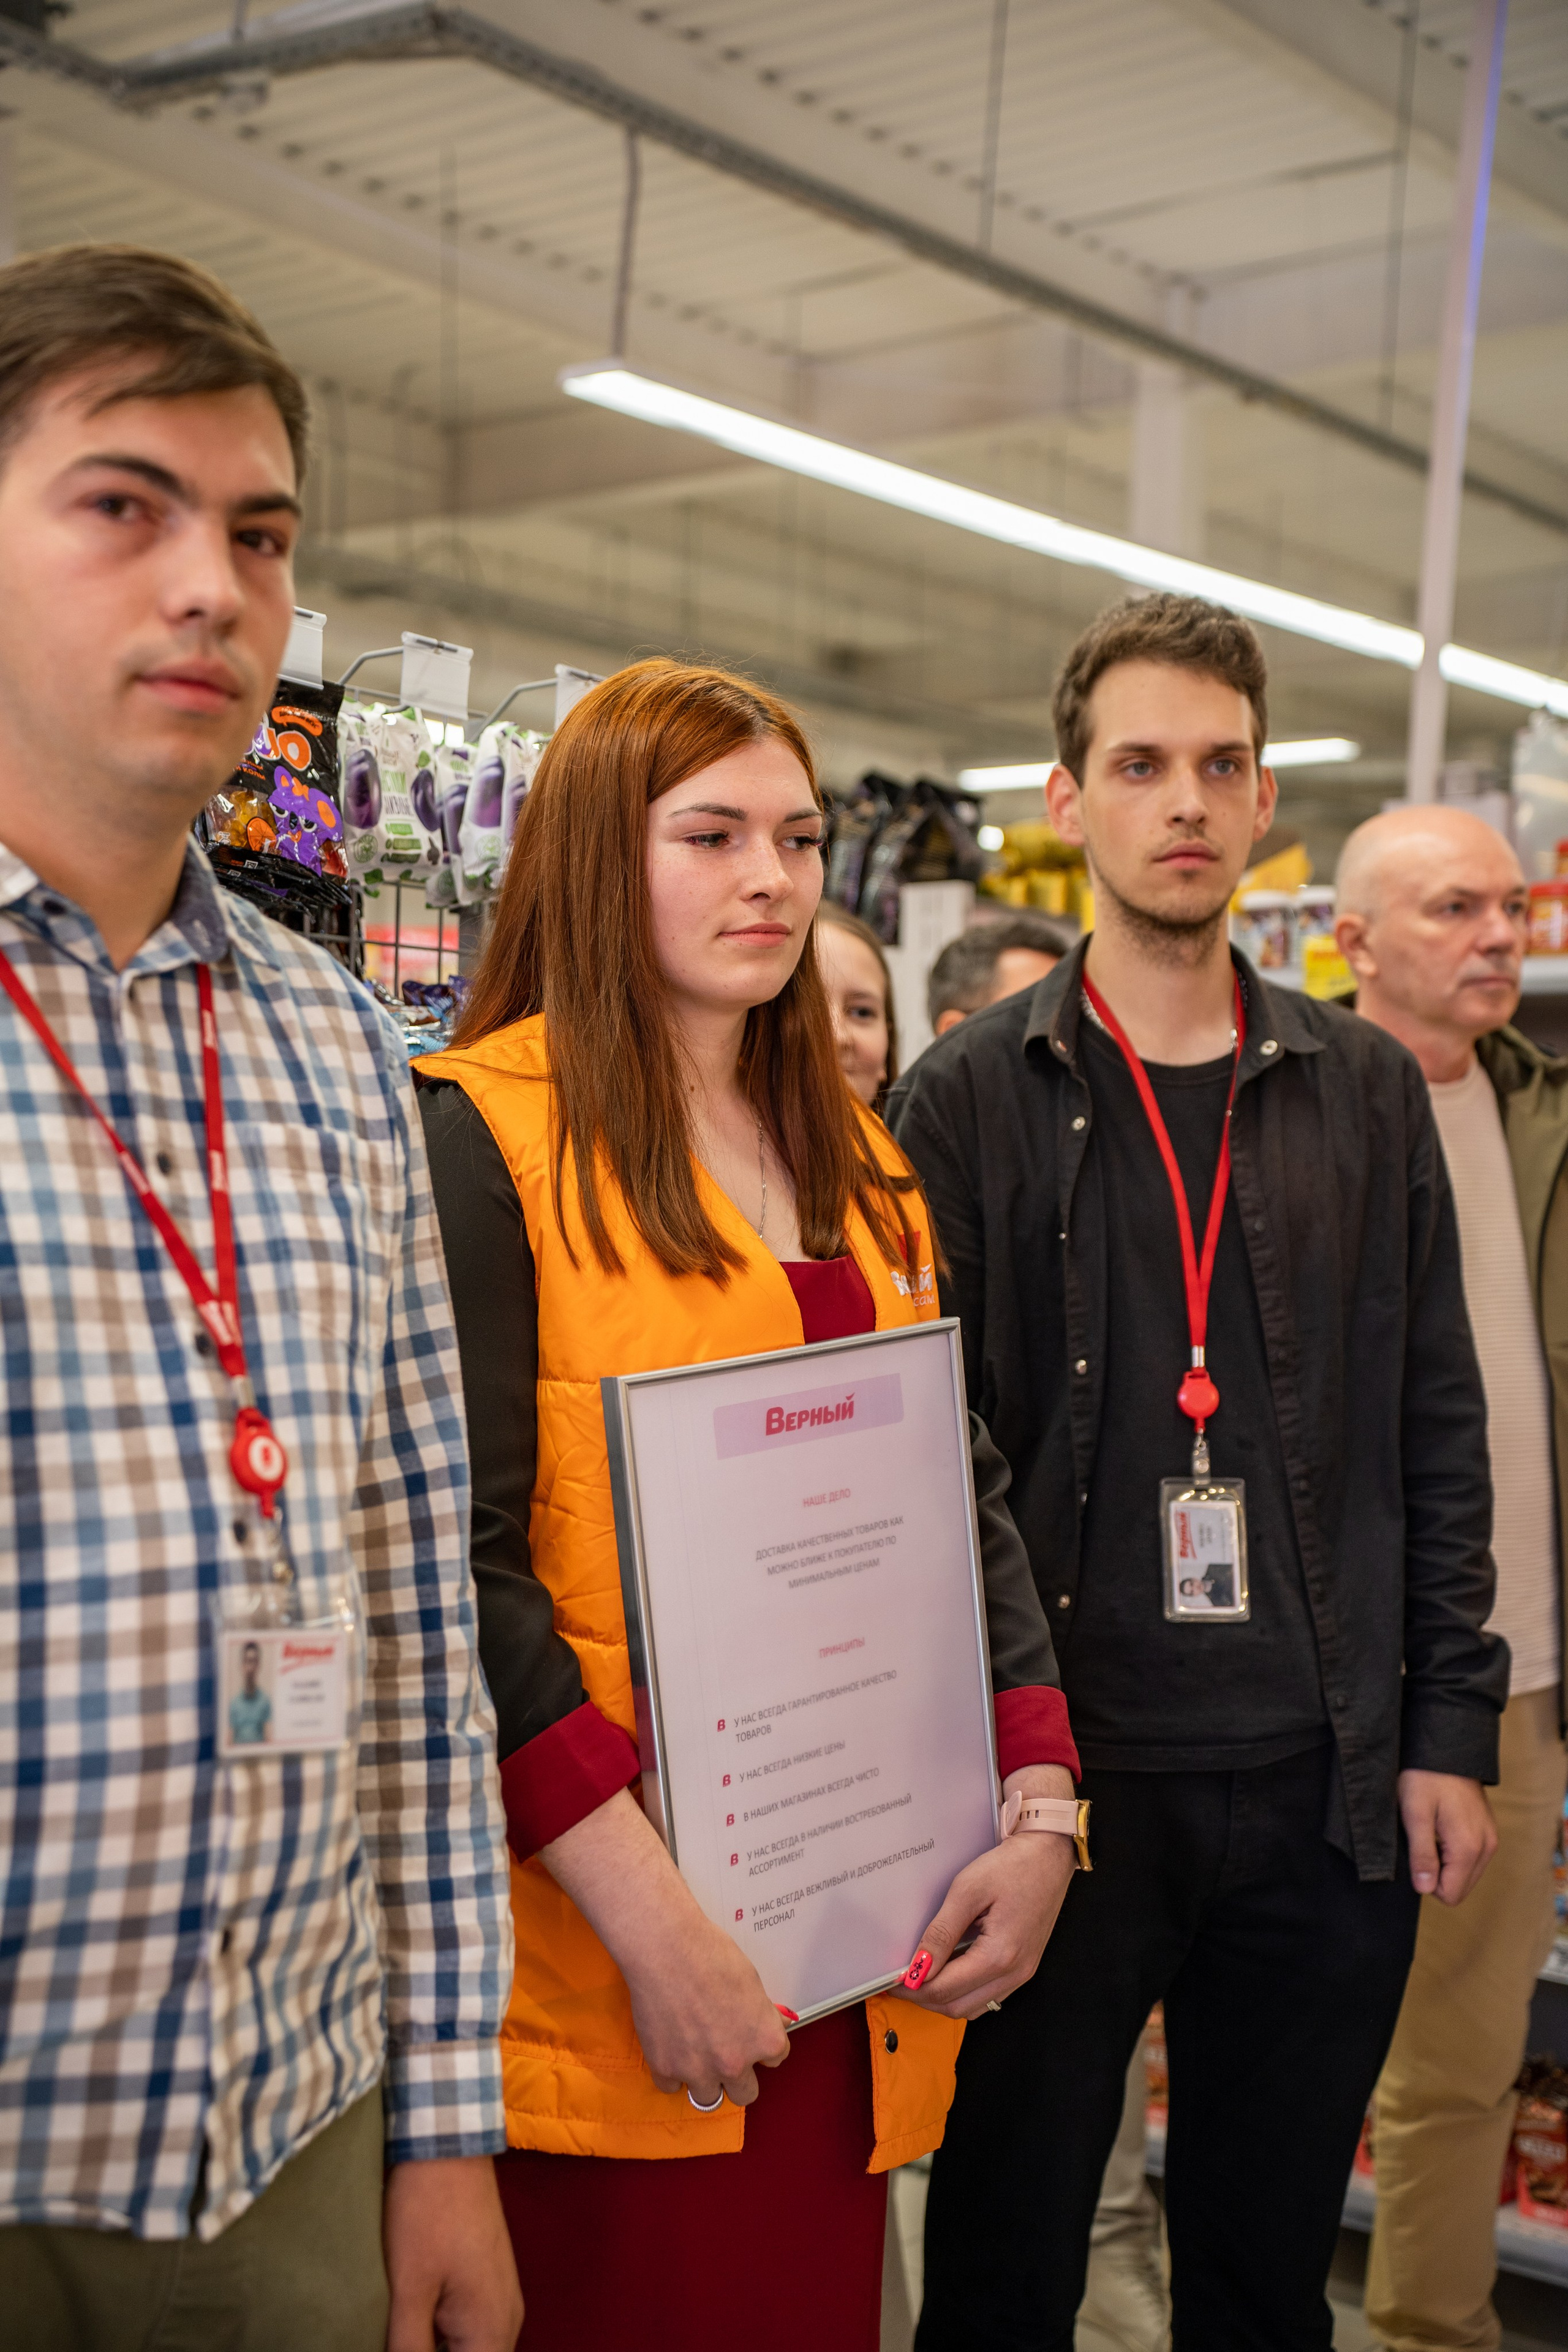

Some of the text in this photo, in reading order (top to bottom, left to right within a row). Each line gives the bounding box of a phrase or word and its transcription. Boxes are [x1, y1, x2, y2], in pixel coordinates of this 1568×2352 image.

[802, 1488, 850, 1507] НАШЕ ДЕЛО
[756, 1515, 904, 1562] ДОСТАВКА КАЧЕСТВЕННЫХ ТОВАРОВ КАК
[767, 1536, 897, 1575] МОЖНО БЛИЖЕ К ПОКУПАТЕЛЮ ПО
[789, 1558, 880, 1589] МИНИМАЛЬНЫМ ЦЕНАМ
[819, 1637, 865, 1658] ПРИНЦИПЫ
[734, 1717, 740, 1727] У
[741, 1713, 756, 1725] НАС
[758, 1703, 787, 1721] ВСЕГДА
[788, 1681, 860, 1711] ГАРАНТИРОВАННОЕ
[861, 1670, 897, 1688] КАЧЕСТВО
[736, 1725, 772, 1743] ТОВАРОВ
[740, 1773, 745, 1782] У
[747, 1768, 761, 1781] НАС
[764, 1758, 792, 1776] ВСЕГДА
[794, 1747, 823, 1764] НИЗКИЕ
[824, 1741, 845, 1757] ЦЕНЫ
[744, 1812, 749, 1821] В
[751, 1803, 779, 1819] НАШИХ
[781, 1786, 826, 1809] МАГАЗИНАХ
[828, 1777, 854, 1793] ВСЕГДА
[856, 1768, 880, 1784] ЧИСТО
[747, 1852, 752, 1861] У
[755, 1845, 769, 1859] НАС
[772, 1836, 799, 1853] ВСЕГДА
[801, 1833, 806, 1842] В
[808, 1819, 843, 1840] НАЛИЧИИ
[845, 1793, 912, 1826] ВОСТРЕБОВАННЫЙ
[748, 1849, 804, 1877] АССОРТИМЕНТ
[752, 1907, 757, 1917] У
[760, 1901, 775, 1914] НАС
[777, 1890, 805, 1909] ВСЕГДА
[807, 1871, 849, 1896] ВЕЖЛИВЫЙ
[850, 1870, 856, 1879] И
[858, 1839, 935, 1878] ДОБРОЖЕЛАТЕЛЬНЫЙ
[754, 1909, 794, 1932] ПЕРСОНАЛ
